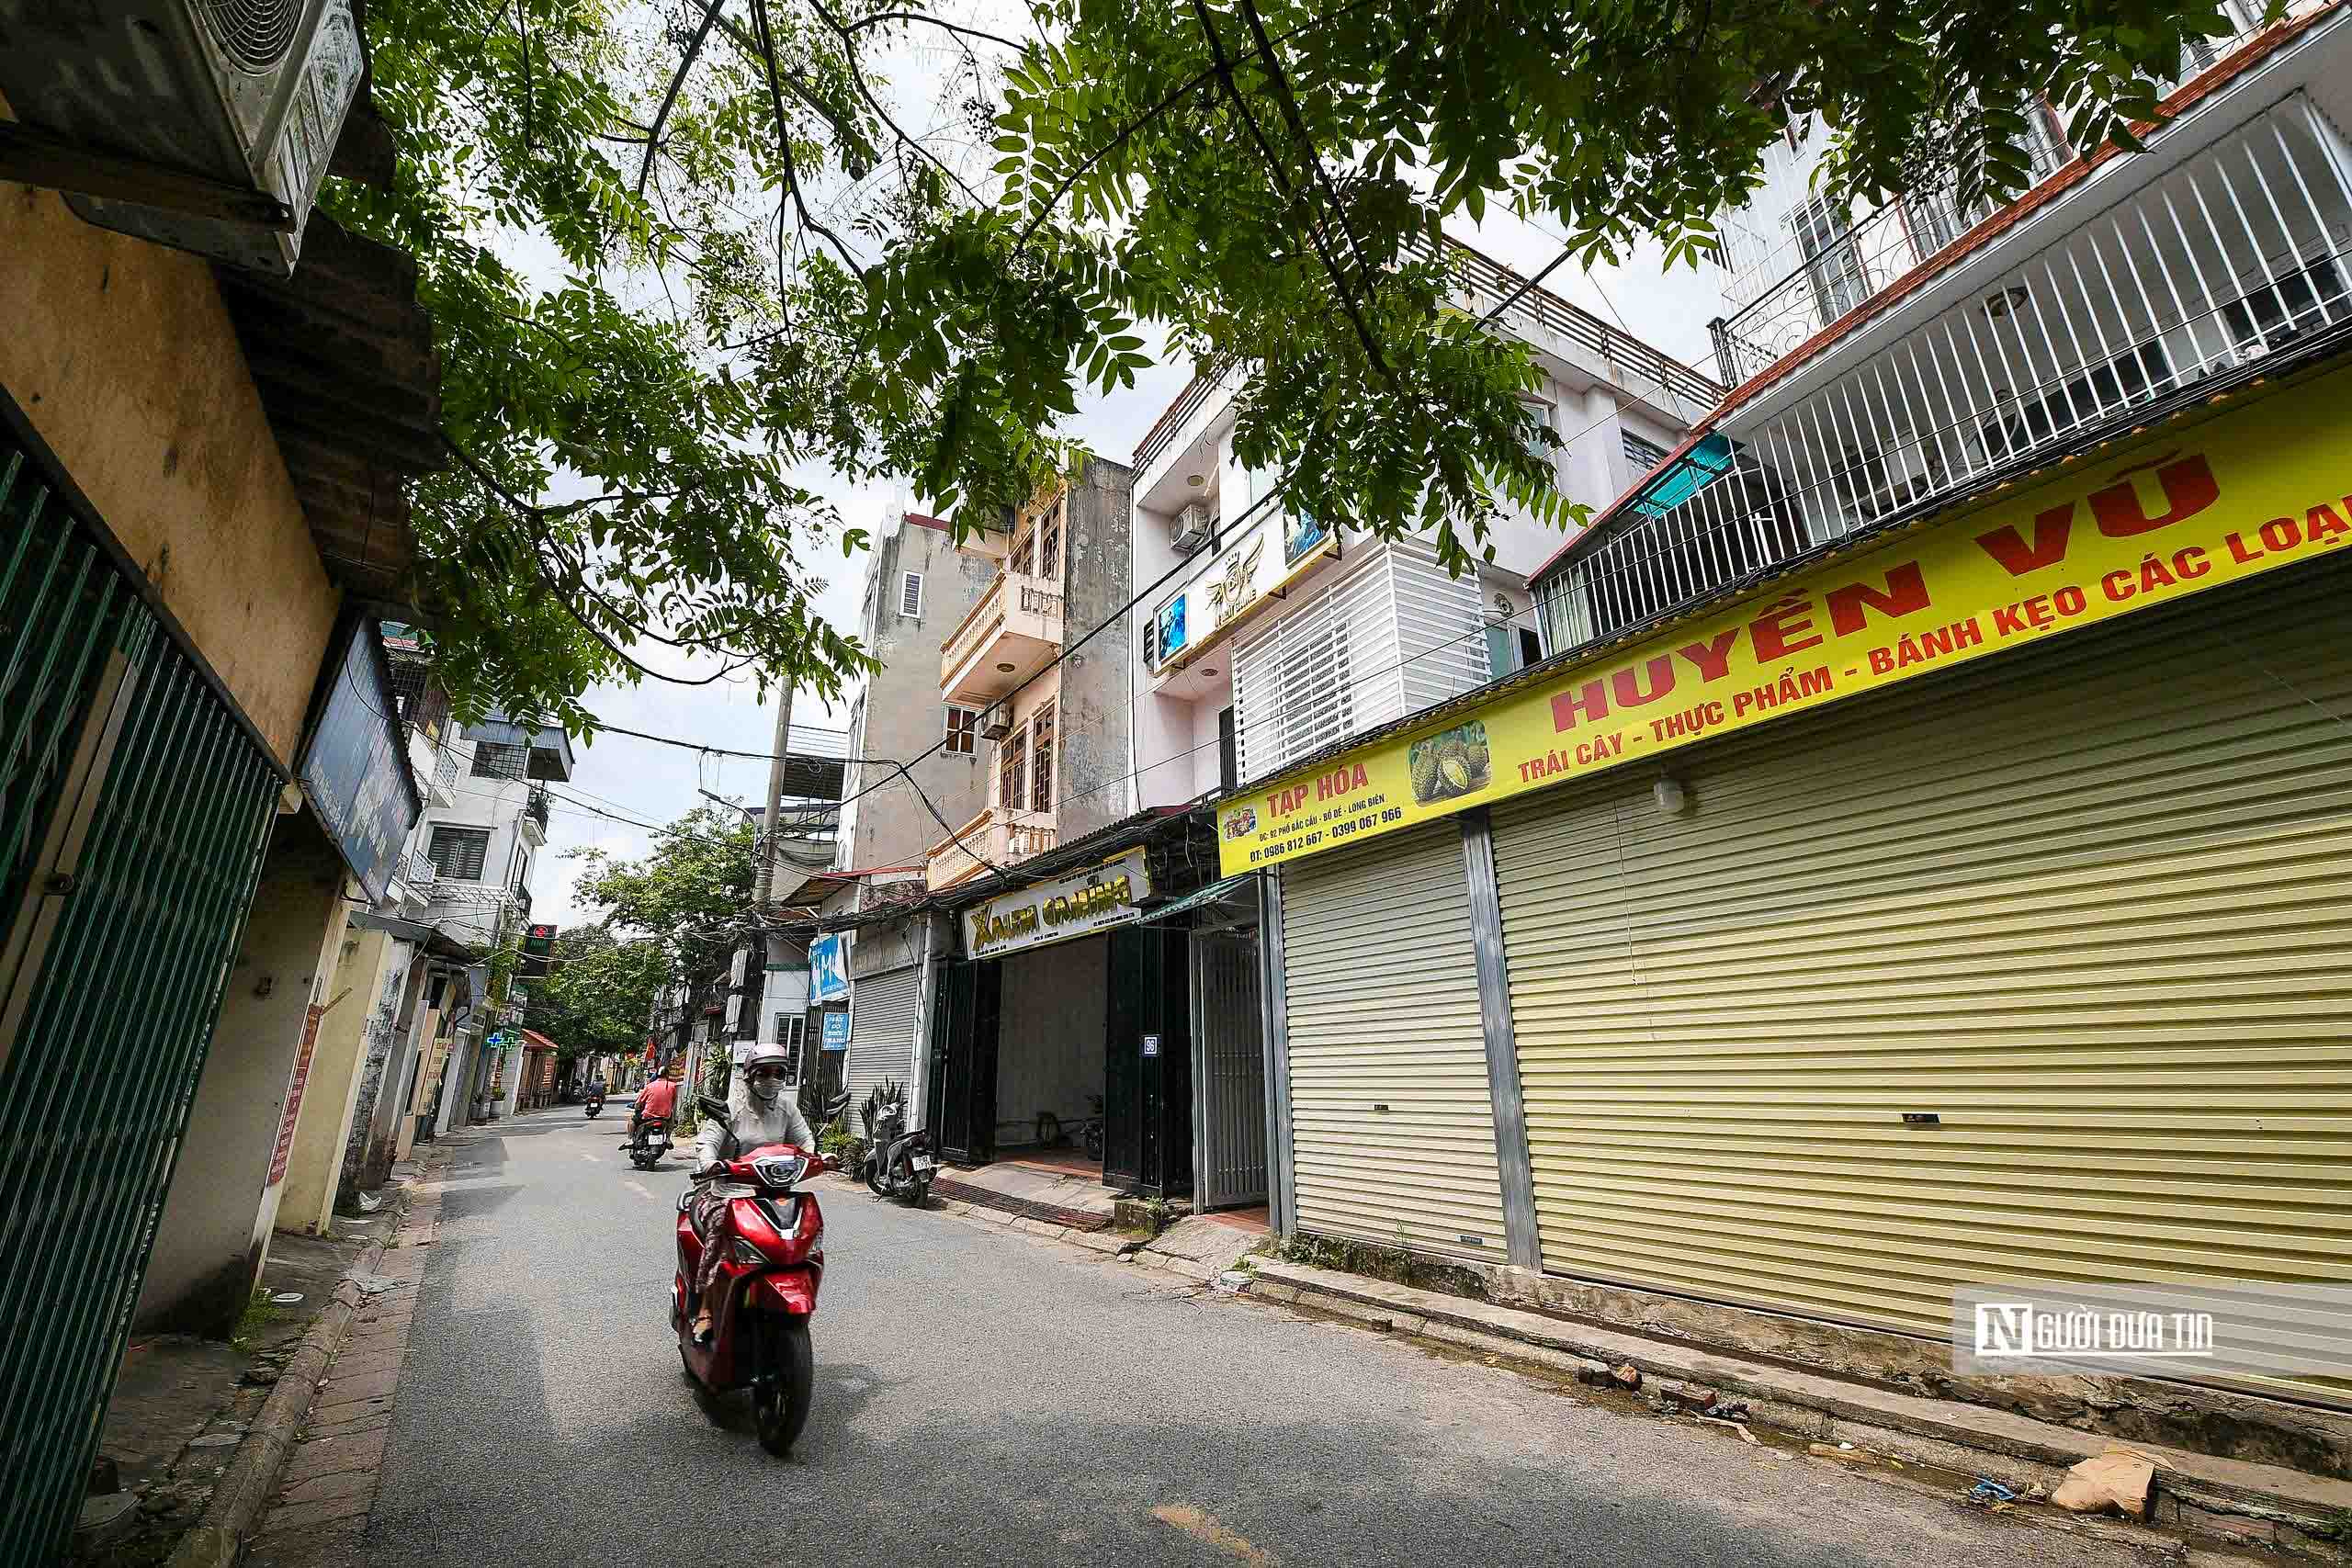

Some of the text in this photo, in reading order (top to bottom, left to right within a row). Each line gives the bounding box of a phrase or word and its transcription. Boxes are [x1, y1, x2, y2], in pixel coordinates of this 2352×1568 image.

[1551, 447, 2220, 733] HUYỀN VŨ
[1518, 749, 1569, 783] TRÁI
[1576, 731, 1623, 765] CÂY
[1649, 701, 1724, 742] THỰC
[1733, 666, 1834, 718] PHẨM
[1868, 617, 1983, 675] BÁNH
[1992, 585, 2087, 637] KẸO
[2101, 547, 2211, 602] CÁC
[1267, 763, 1369, 818] TẠP HÓA
[1348, 800, 1367, 814] LONG
[1264, 842, 1285, 859] 0986
[1286, 837, 1305, 852] 812
[1306, 830, 1323, 846] 667
[1332, 823, 1357, 839] 0399
[1359, 814, 1378, 830] 067
[1381, 807, 1402, 824] 966
